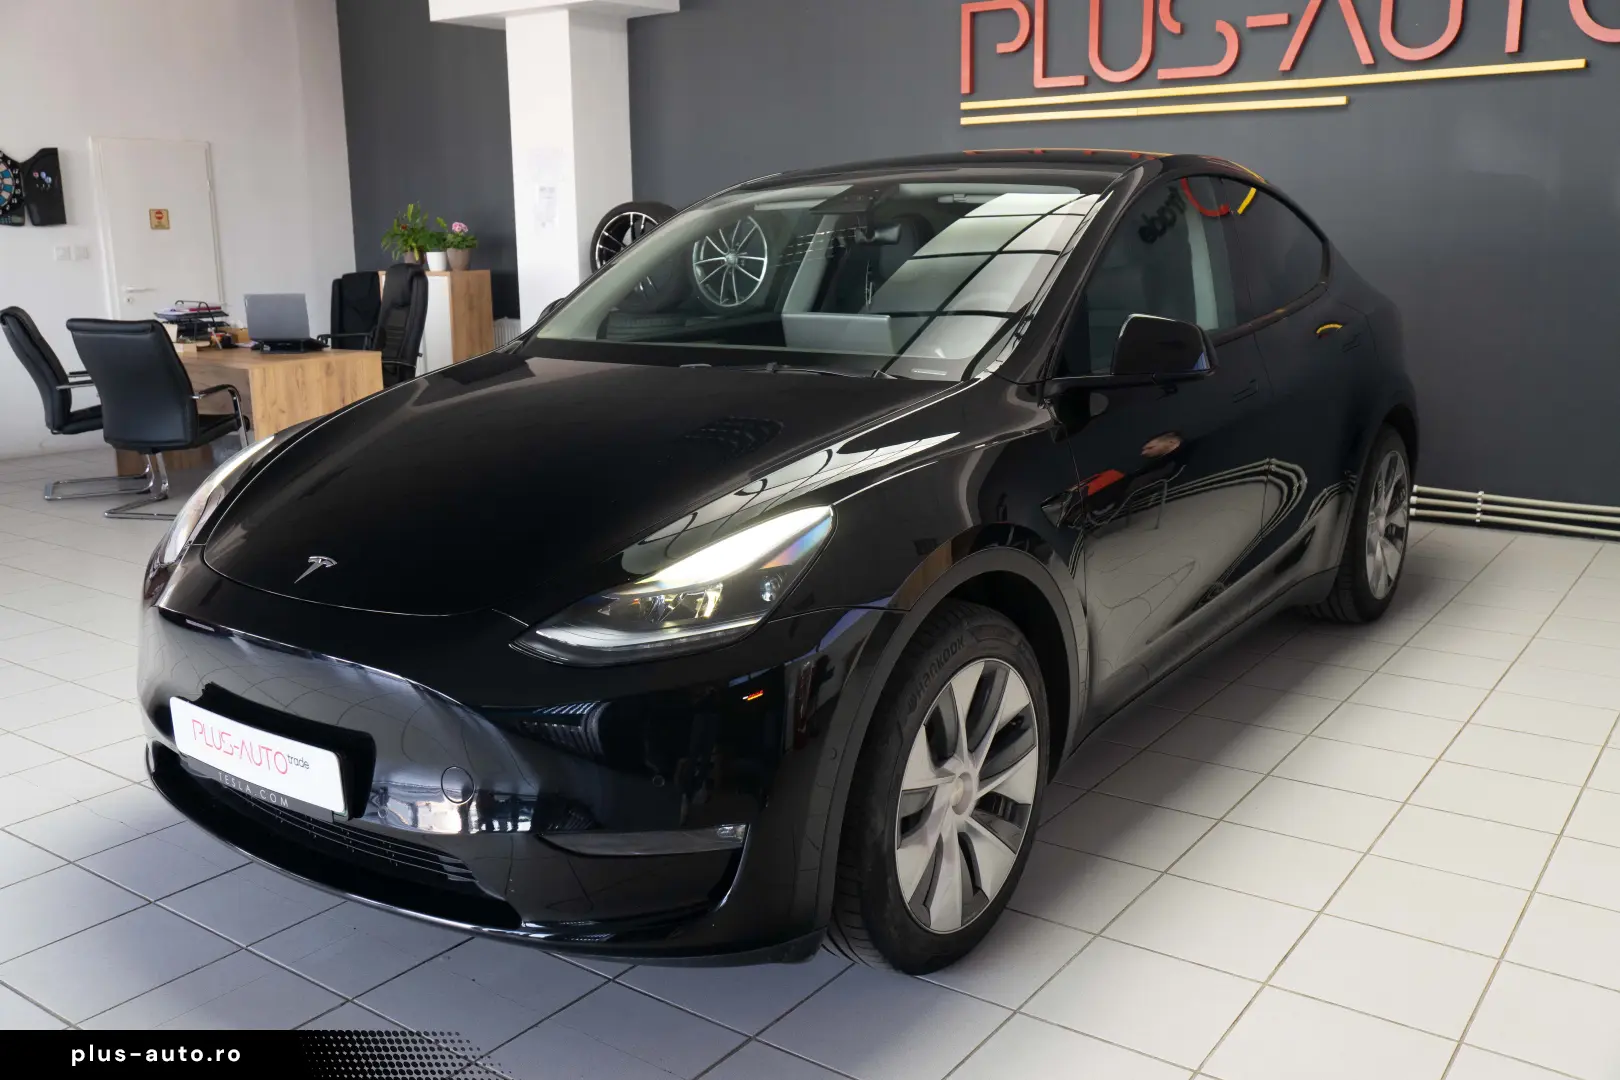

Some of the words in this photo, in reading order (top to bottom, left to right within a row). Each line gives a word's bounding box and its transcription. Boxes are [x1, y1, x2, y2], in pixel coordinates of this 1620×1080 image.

[191, 719, 288, 775] PLUS-AUTO
[287, 753, 310, 770] trade
[217, 771, 289, 808] TESLA.COM
